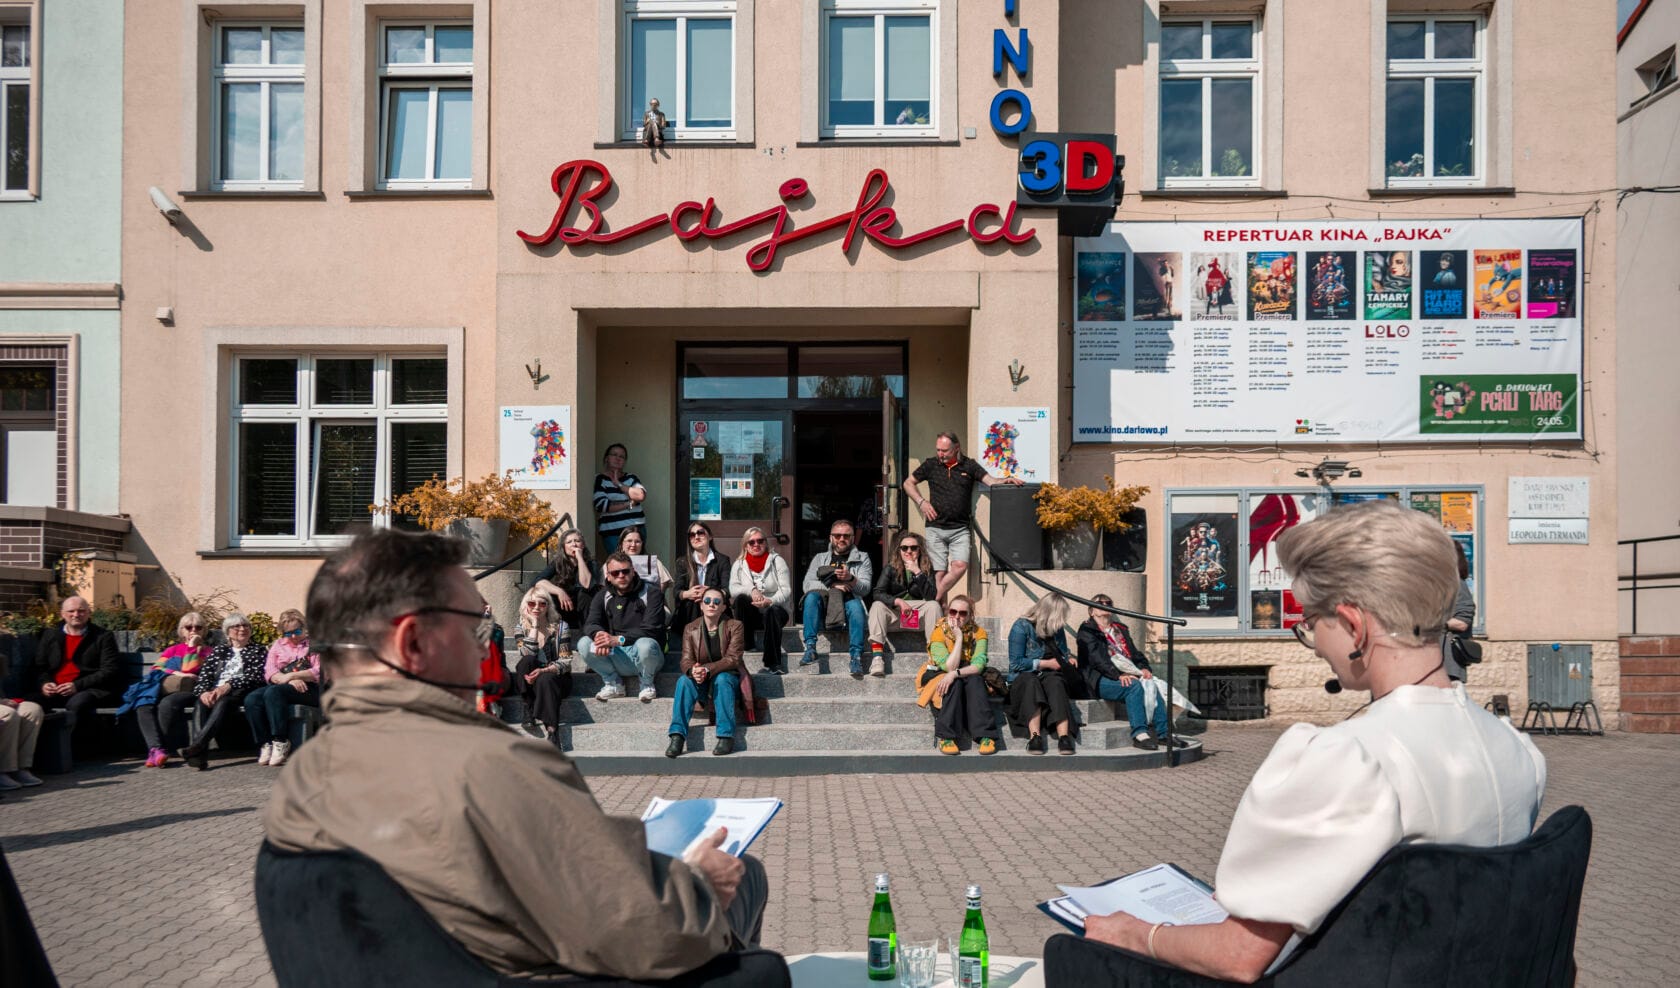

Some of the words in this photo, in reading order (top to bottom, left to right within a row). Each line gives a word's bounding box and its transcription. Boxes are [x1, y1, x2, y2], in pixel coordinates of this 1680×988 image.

[1018, 140, 1115, 194] 3D
[517, 159, 1036, 271] Bajka
[1203, 228, 1313, 242] REPERTUAR
[1320, 228, 1368, 241] KINA
[1366, 293, 1409, 302] TAMARY
[1365, 324, 1410, 338] LOLO
[1481, 391, 1519, 411] PCHLI
[1528, 391, 1563, 411] TARG
[1511, 531, 1547, 540] LEOPOLDA
[1549, 531, 1586, 540] TYRMANDA
